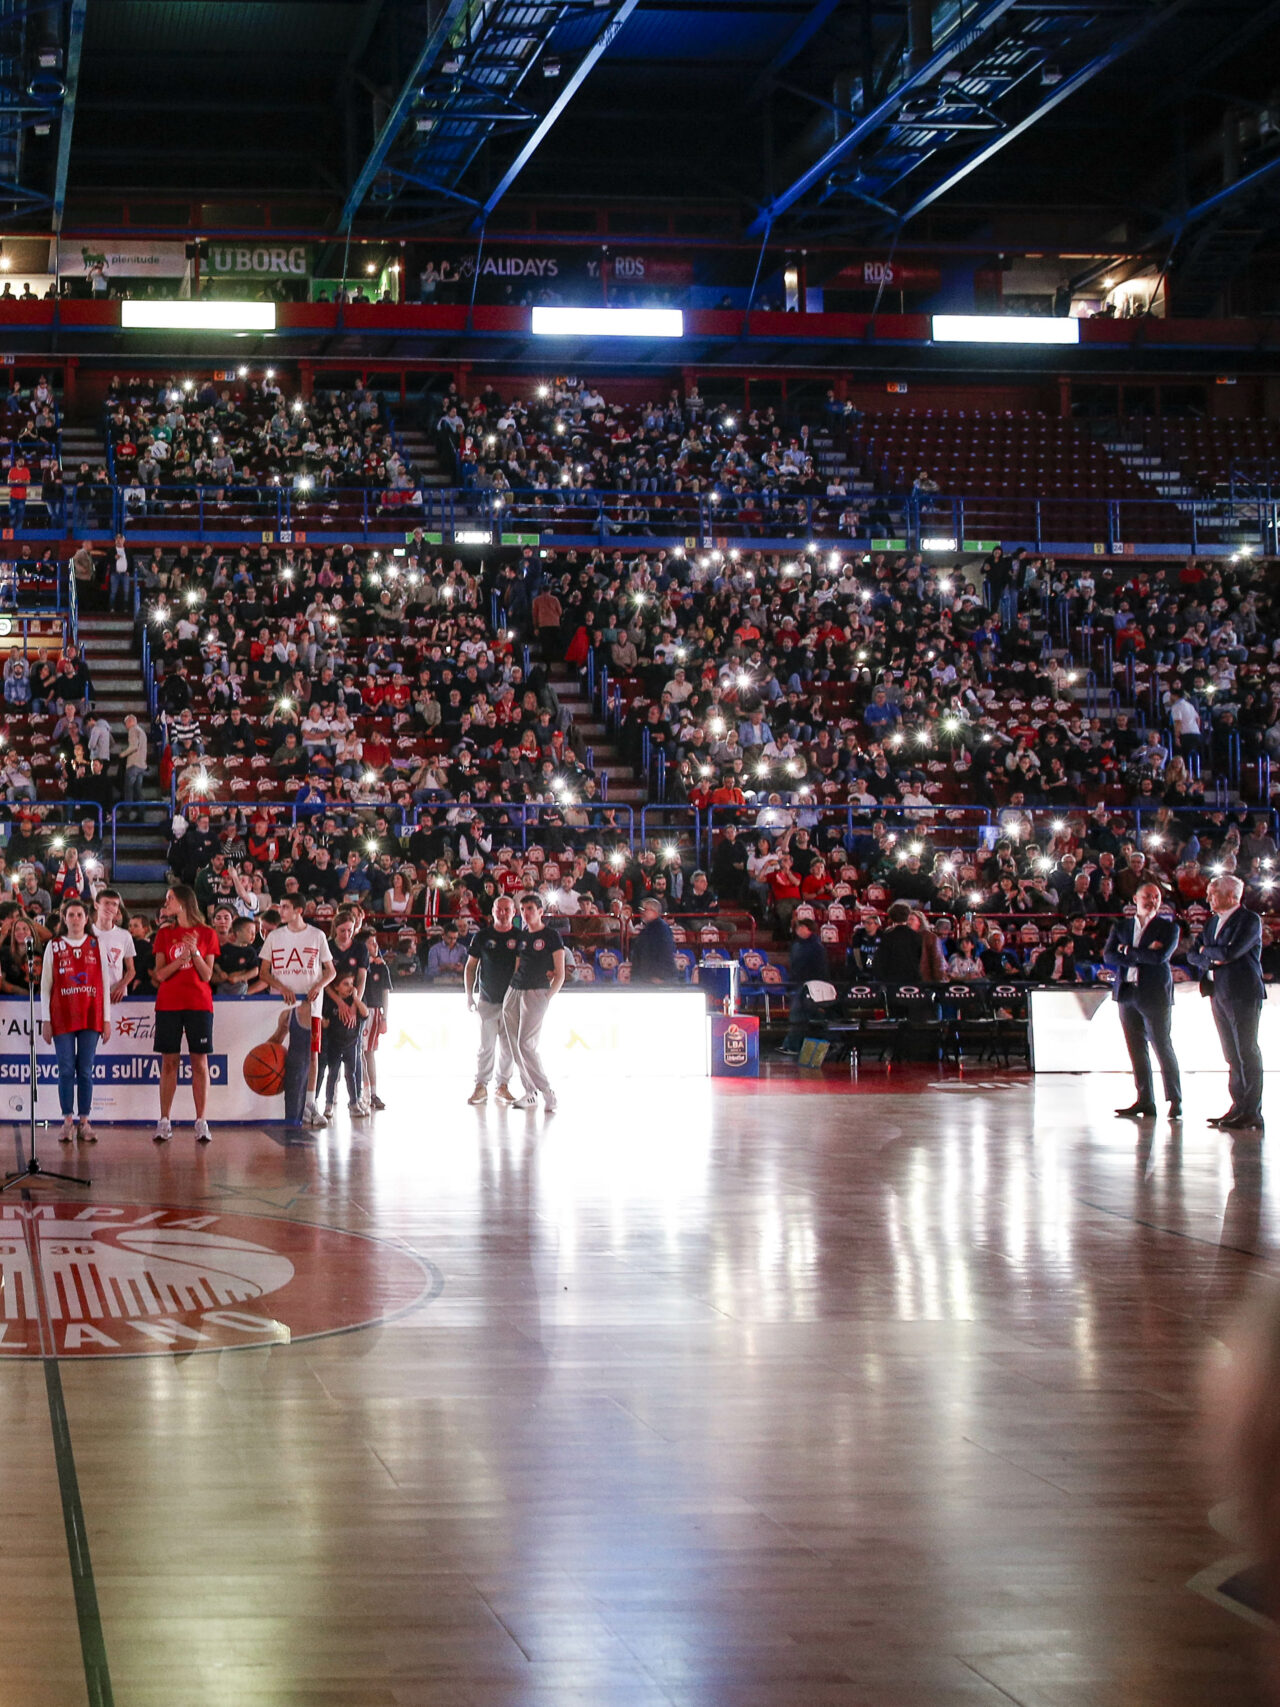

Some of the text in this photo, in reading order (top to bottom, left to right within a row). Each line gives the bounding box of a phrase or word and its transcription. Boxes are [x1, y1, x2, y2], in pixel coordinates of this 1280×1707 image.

[112, 255, 159, 264] plenitude
[615, 256, 644, 275] RDS
[864, 262, 893, 280] RDS
[271, 947, 319, 970] EA7
[50, 1246, 96, 1256] 36
